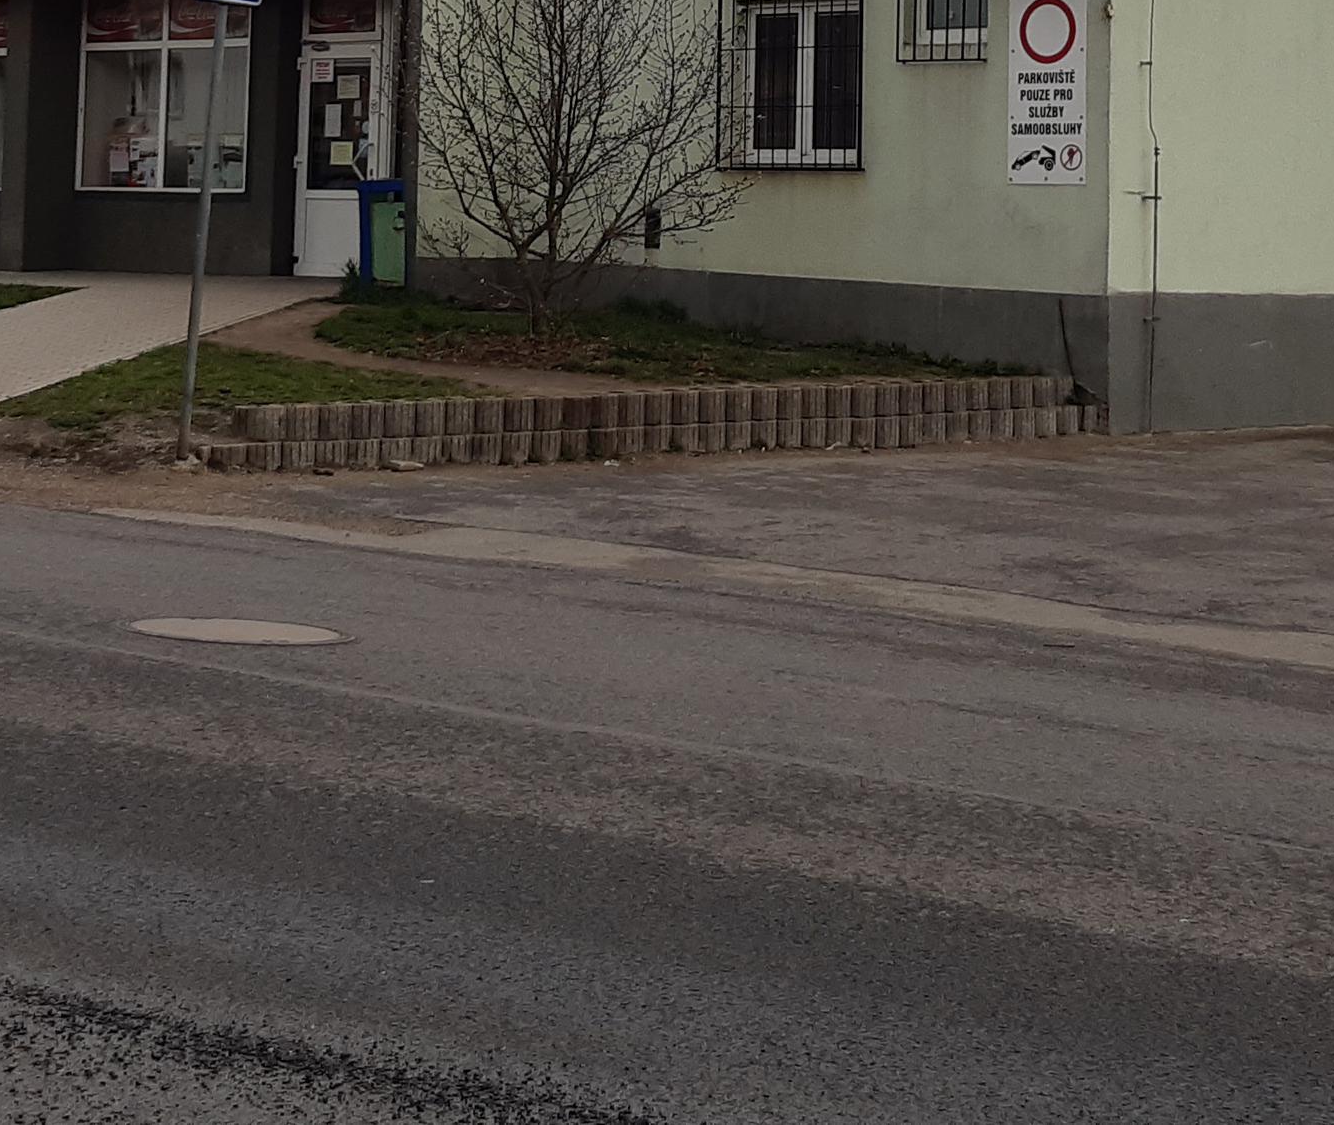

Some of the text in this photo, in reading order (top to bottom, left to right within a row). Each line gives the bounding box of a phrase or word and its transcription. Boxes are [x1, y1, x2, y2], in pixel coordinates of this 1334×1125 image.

[1018, 69, 1075, 84] PARKOVIŠTĚ
[1020, 89, 1073, 101] POUZE PRO
[1028, 103, 1064, 118] SLUŽBY
[1011, 123, 1082, 135] SAMOOBSLUHY
